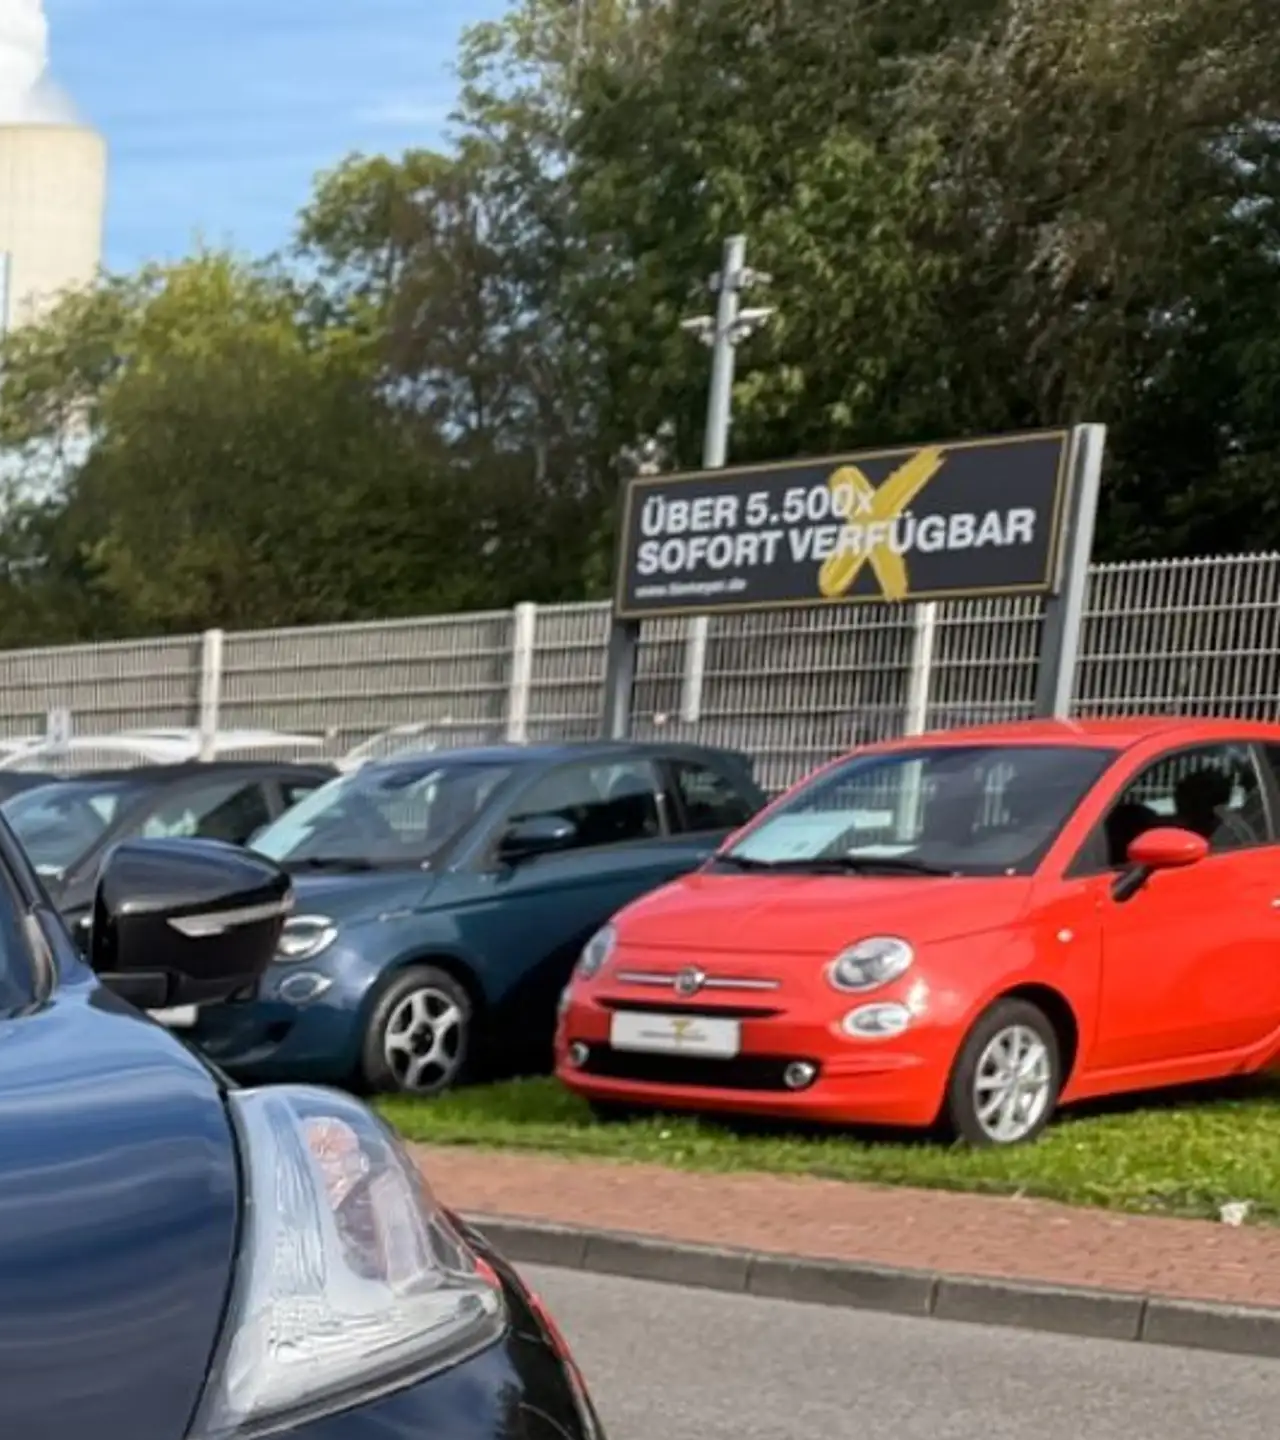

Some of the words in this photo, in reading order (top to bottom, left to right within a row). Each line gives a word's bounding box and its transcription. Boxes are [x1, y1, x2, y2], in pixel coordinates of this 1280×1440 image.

[636, 531, 782, 576] SOFORT
[791, 507, 1037, 562] VERFÜGBAR
[641, 494, 738, 537] ÜBER
